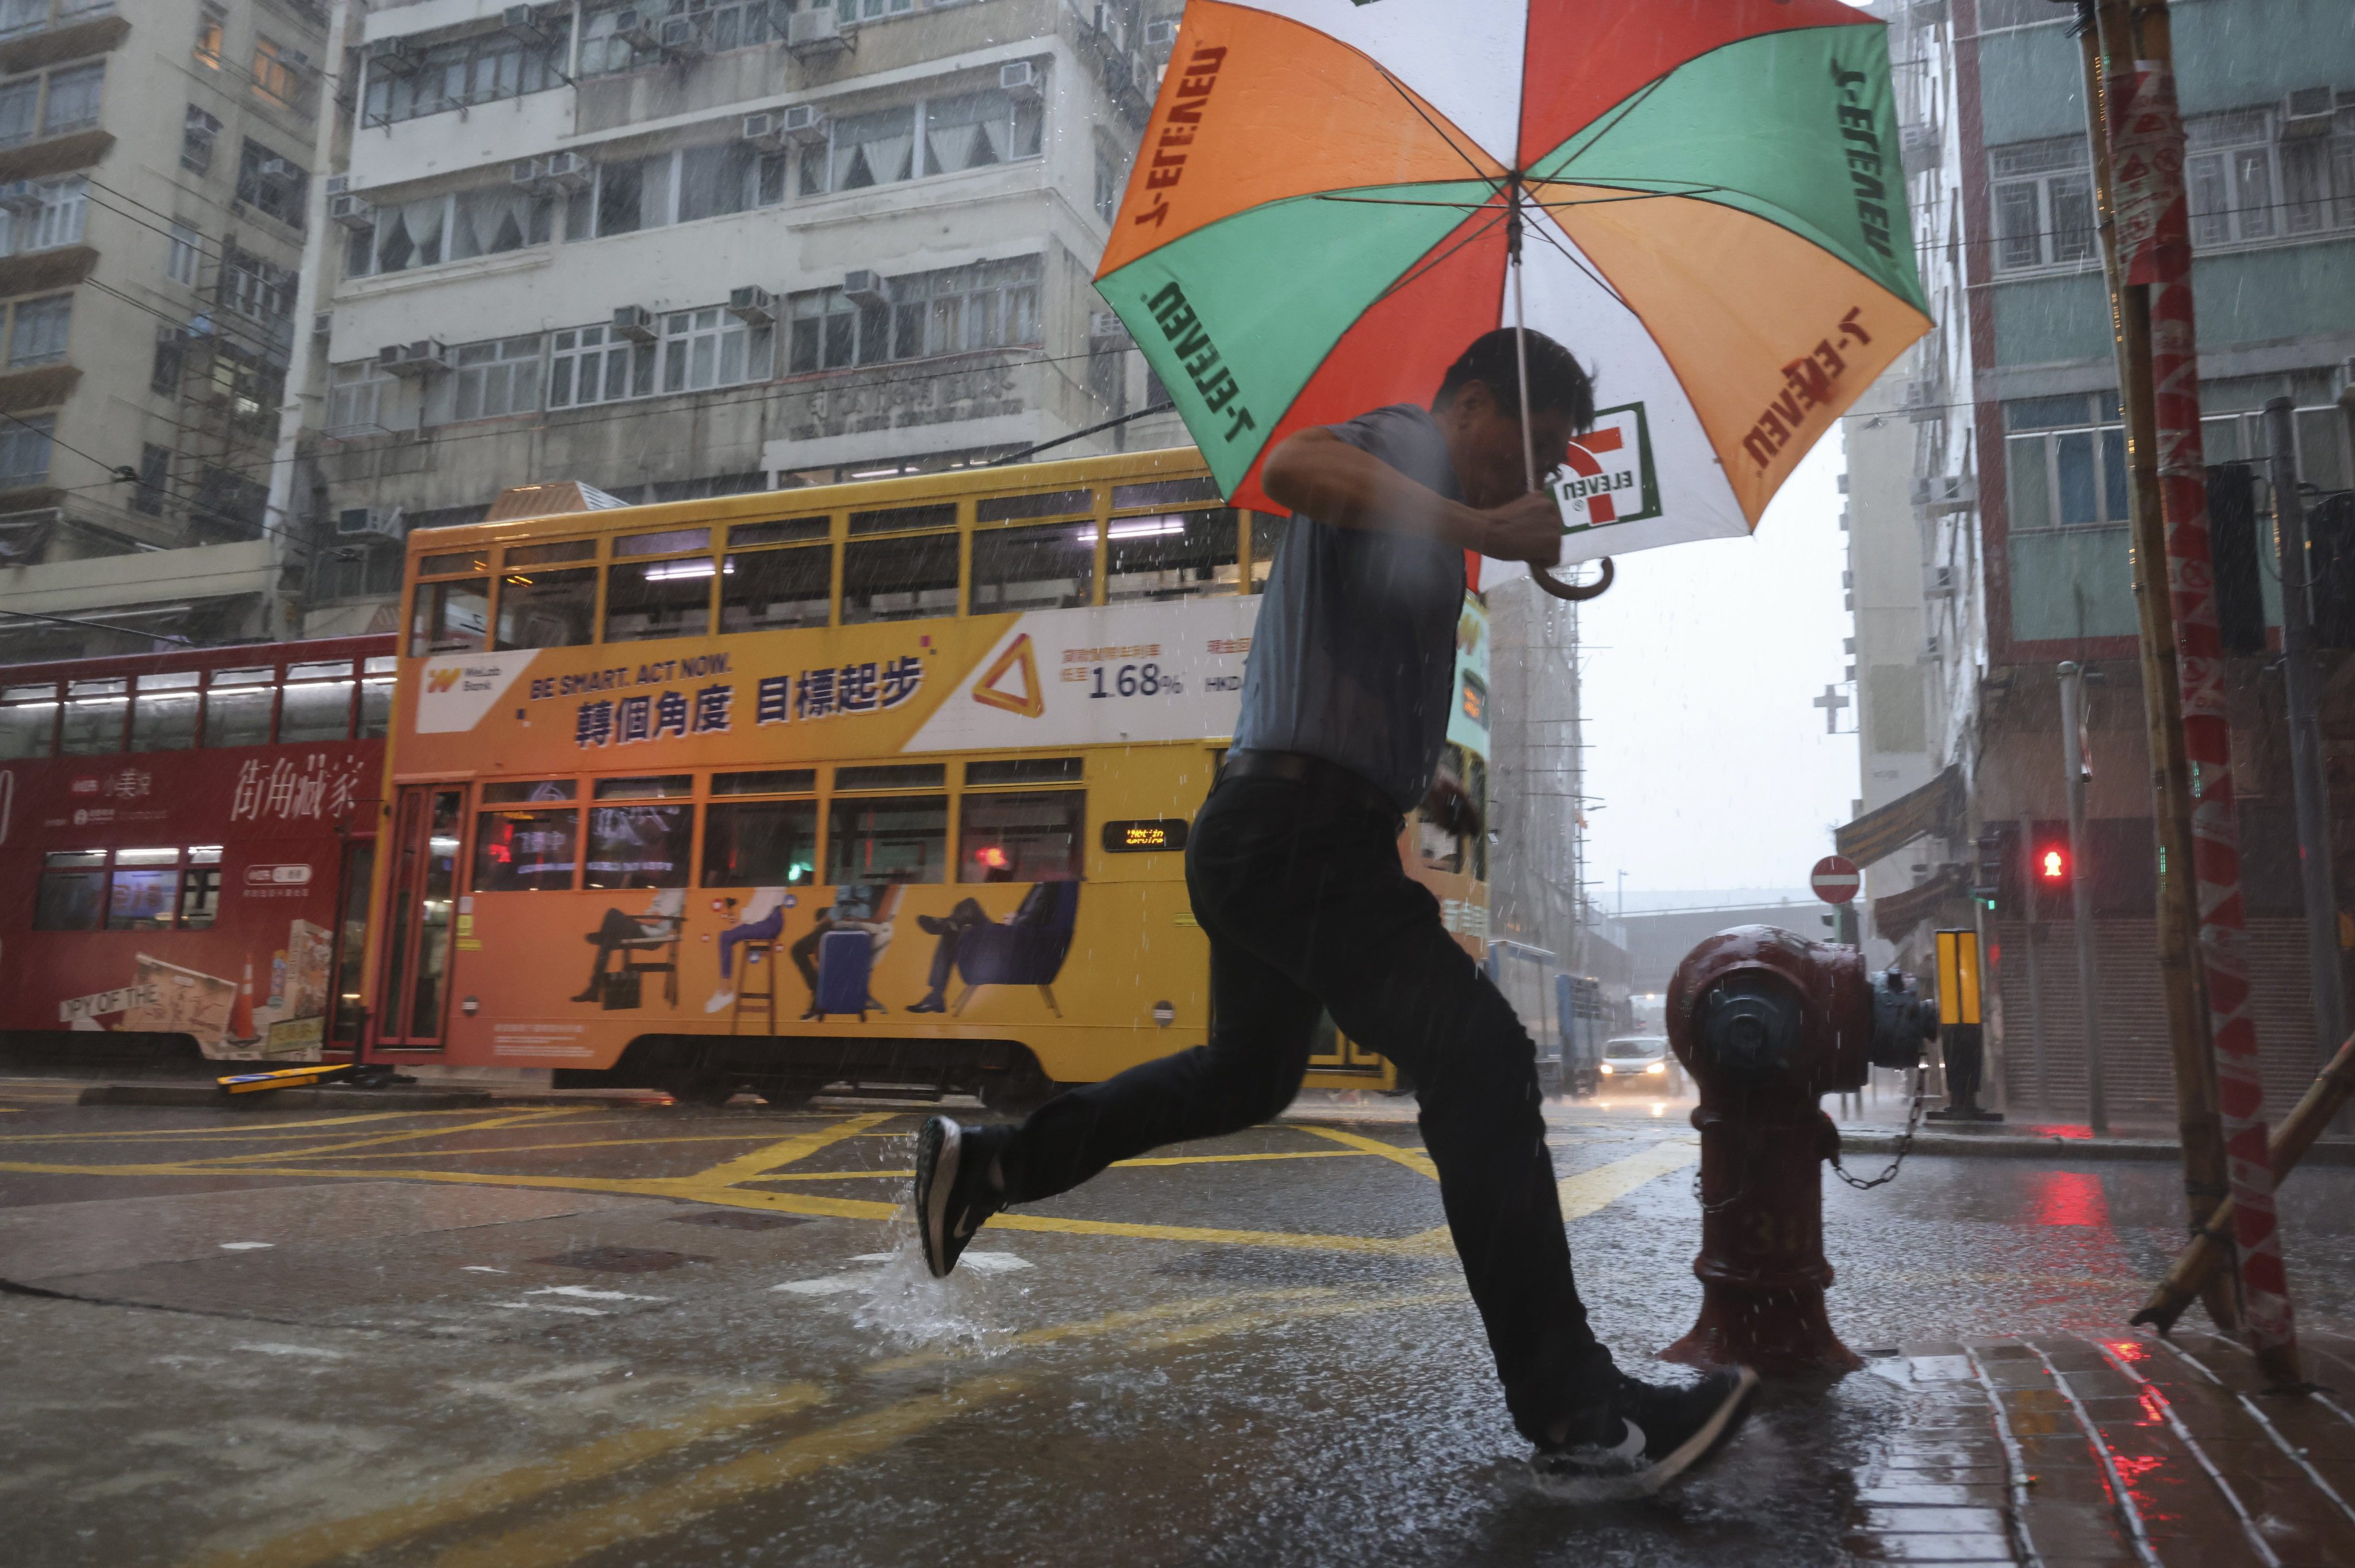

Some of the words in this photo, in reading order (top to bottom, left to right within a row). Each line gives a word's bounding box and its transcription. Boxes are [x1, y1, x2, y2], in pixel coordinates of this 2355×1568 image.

[531, 677, 556, 700] BE
[636, 660, 677, 686] ACT
[576, 684, 736, 750] 轉個角度
[758, 656, 926, 727] 目標起步
